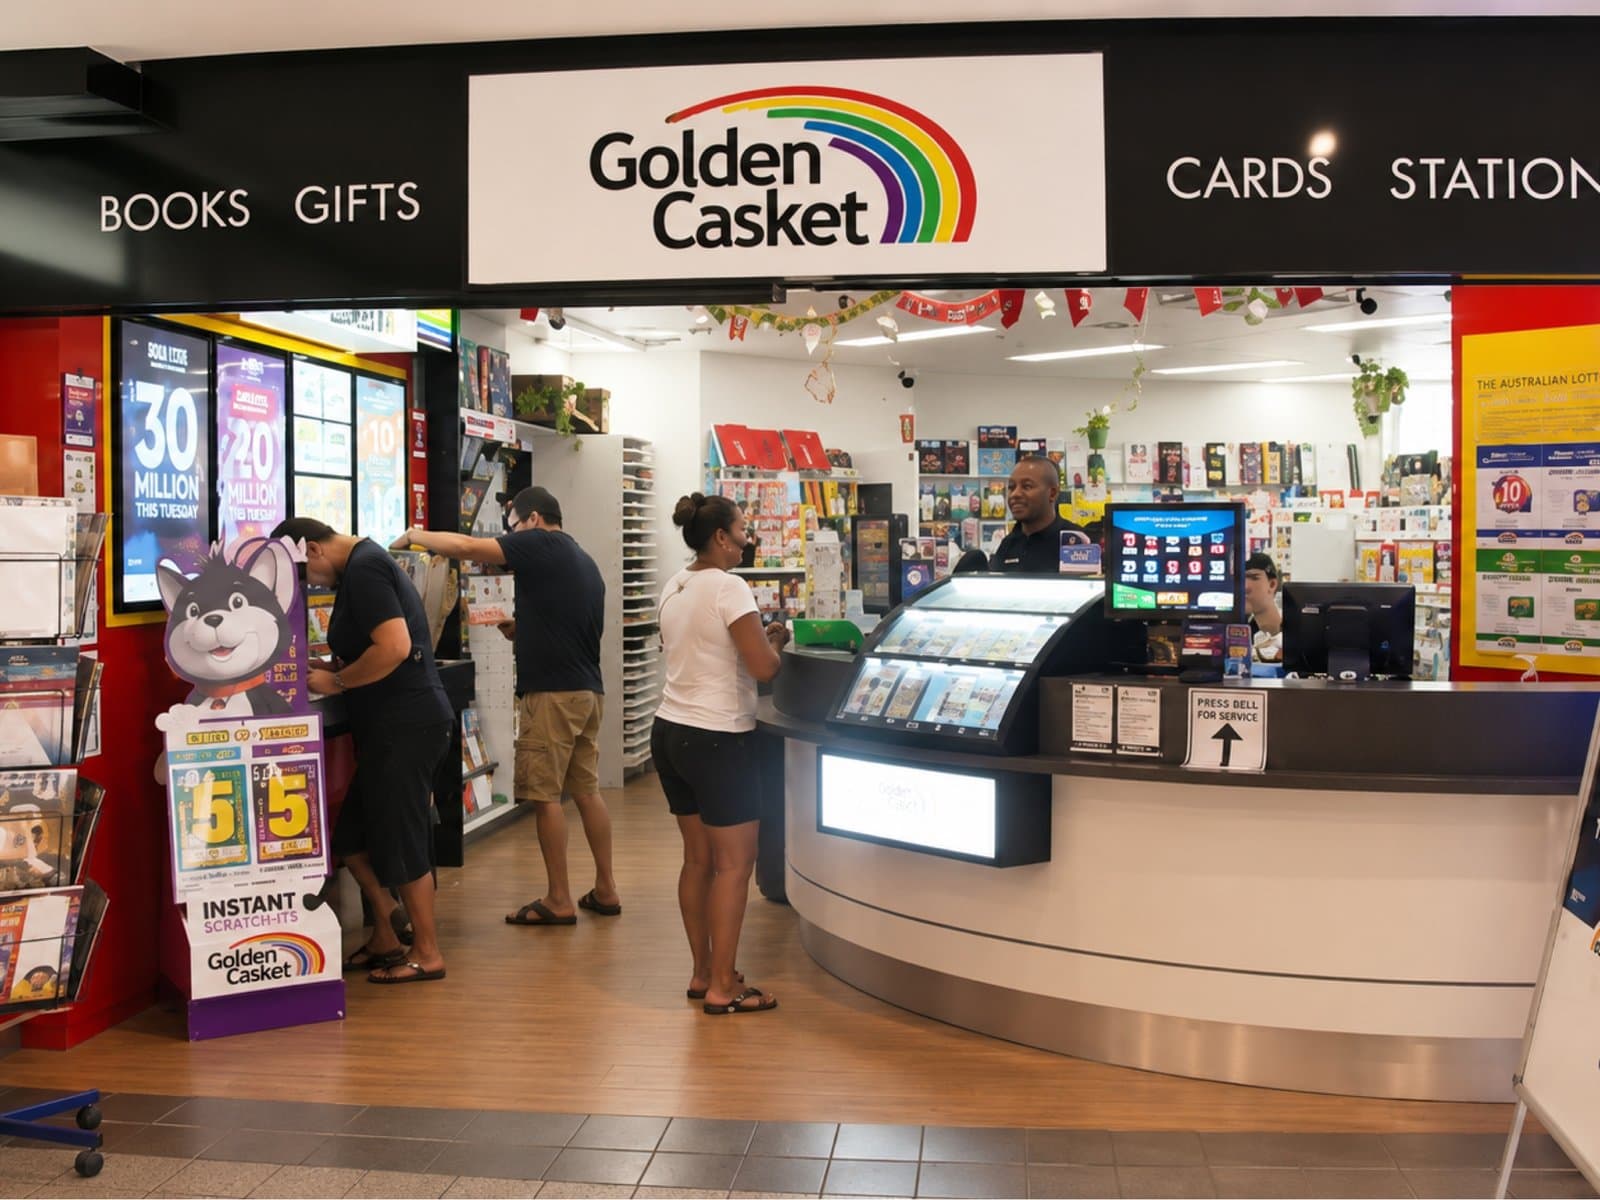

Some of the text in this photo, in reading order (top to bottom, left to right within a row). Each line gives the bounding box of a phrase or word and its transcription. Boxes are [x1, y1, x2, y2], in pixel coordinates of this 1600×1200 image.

[589, 127, 821, 191] Golden
[1166, 156, 1332, 199] CARDS
[101, 181, 421, 232] BOOKS GIFTS
[652, 188, 870, 250] Casket
[1477, 380, 1496, 390] THE
[1500, 375, 1568, 389] AUSTRALIAN
[135, 381, 198, 471] 30
[225, 417, 274, 481] 20
[135, 471, 199, 500] MILLION
[228, 483, 277, 506] MILLION
[1501, 481, 1521, 503] 10
[135, 502, 199, 520] THIS TUESDAY
[1197, 698, 1229, 709] PRESS
[1197, 710, 1258, 722] FOR SERVICE
[268, 774, 309, 837] 5
[203, 892, 296, 919] INSTANT
[204, 910, 298, 934] SCRATCH-ITS
[208, 948, 277, 970] Golden
[226, 961, 291, 985] Casket
